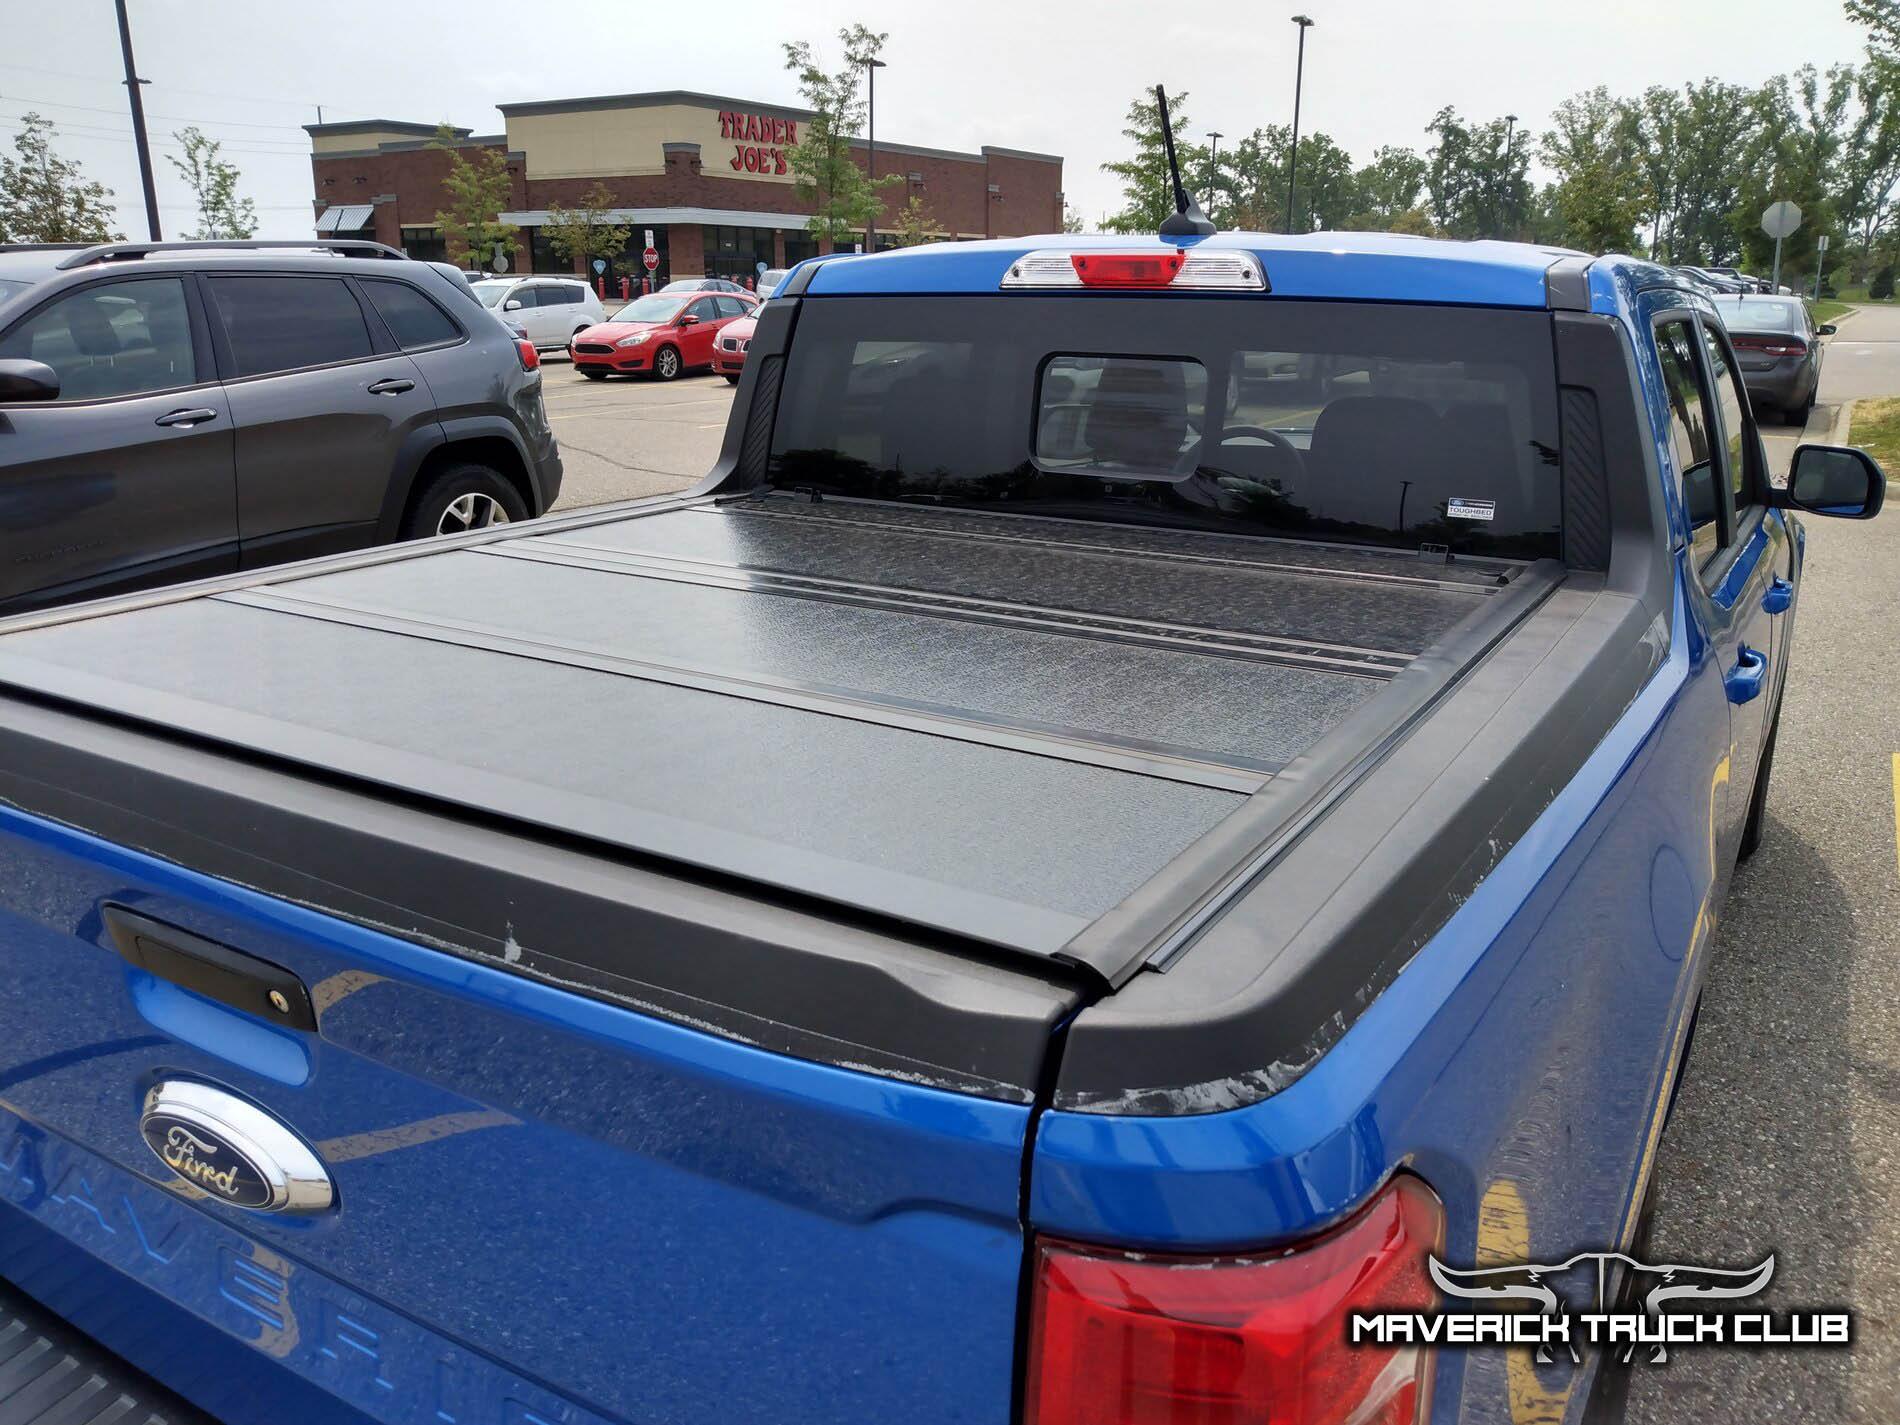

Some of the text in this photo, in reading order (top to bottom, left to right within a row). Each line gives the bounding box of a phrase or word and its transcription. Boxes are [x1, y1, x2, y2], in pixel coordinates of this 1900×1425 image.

[718, 110, 799, 145] TRADER
[730, 144, 788, 175] JOE'S
[644, 254, 658, 263] STOP
[1449, 507, 1492, 516] TOUGHBED
[164, 1125, 239, 1196] Ford
